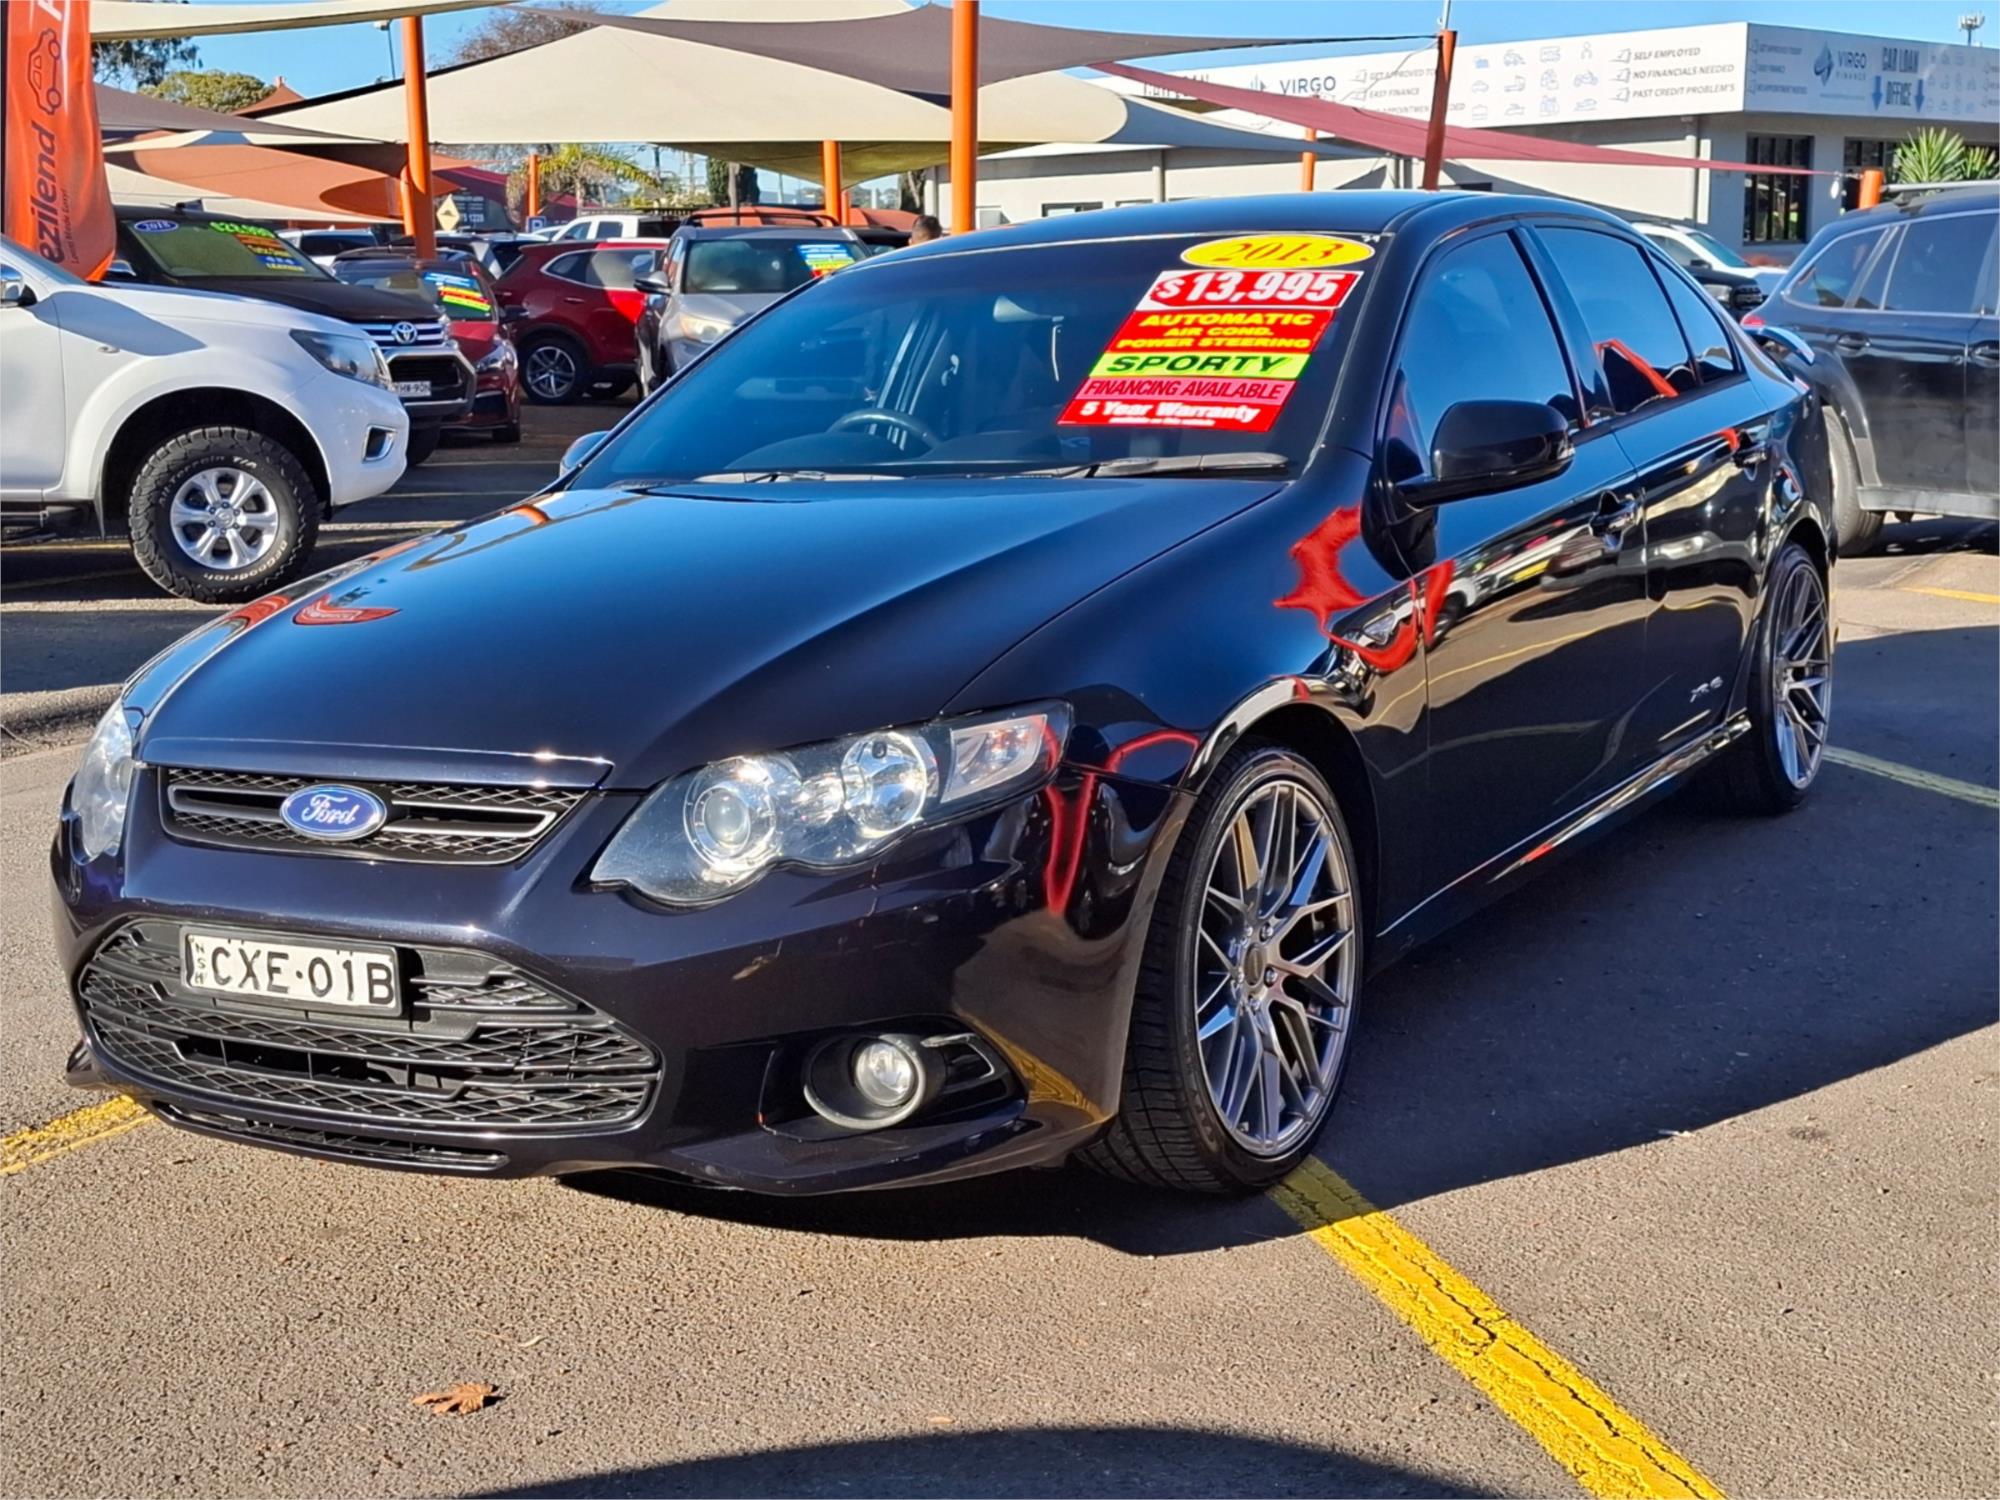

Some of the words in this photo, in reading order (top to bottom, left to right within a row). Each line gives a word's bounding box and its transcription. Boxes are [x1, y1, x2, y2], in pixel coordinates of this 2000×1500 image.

[1633, 51, 1652, 61] SELF
[1654, 47, 1701, 59] EMPLOYED
[1837, 51, 1867, 69] VIRGO
[1632, 70, 1647, 79] NO
[1648, 66, 1698, 78] FINANCIALS
[1700, 64, 1735, 74] NEEDED
[1280, 75, 1336, 94] VIRGO
[1389, 87, 1420, 97] FINANCE
[1632, 89, 1653, 98] PAST
[1654, 86, 1685, 97] CREDIT
[1686, 83, 1735, 95] PROBLEM'S
[30, 120, 65, 264] ezilend
[63, 215, 73, 240] Made
[1215, 242, 1344, 262] 2013
[1155, 271, 1346, 303] $13,995
[1139, 313, 1315, 327] AUTOMATIC
[1163, 326, 1204, 337] AIR
[1208, 327, 1274, 337] COND.
[1116, 338, 1195, 349] POWER
[1197, 337, 1312, 349] STEERING
[1105, 355, 1289, 373] SPORTY
[1084, 380, 1178, 396] FINANCING
[1180, 381, 1285, 400] AVAILABLE
[1080, 400, 1100, 416] 5
[1102, 401, 1154, 416] Year
[1155, 401, 1261, 423] Warranty
[232, 455, 258, 469] T/A
[302, 793, 359, 826] Ford
